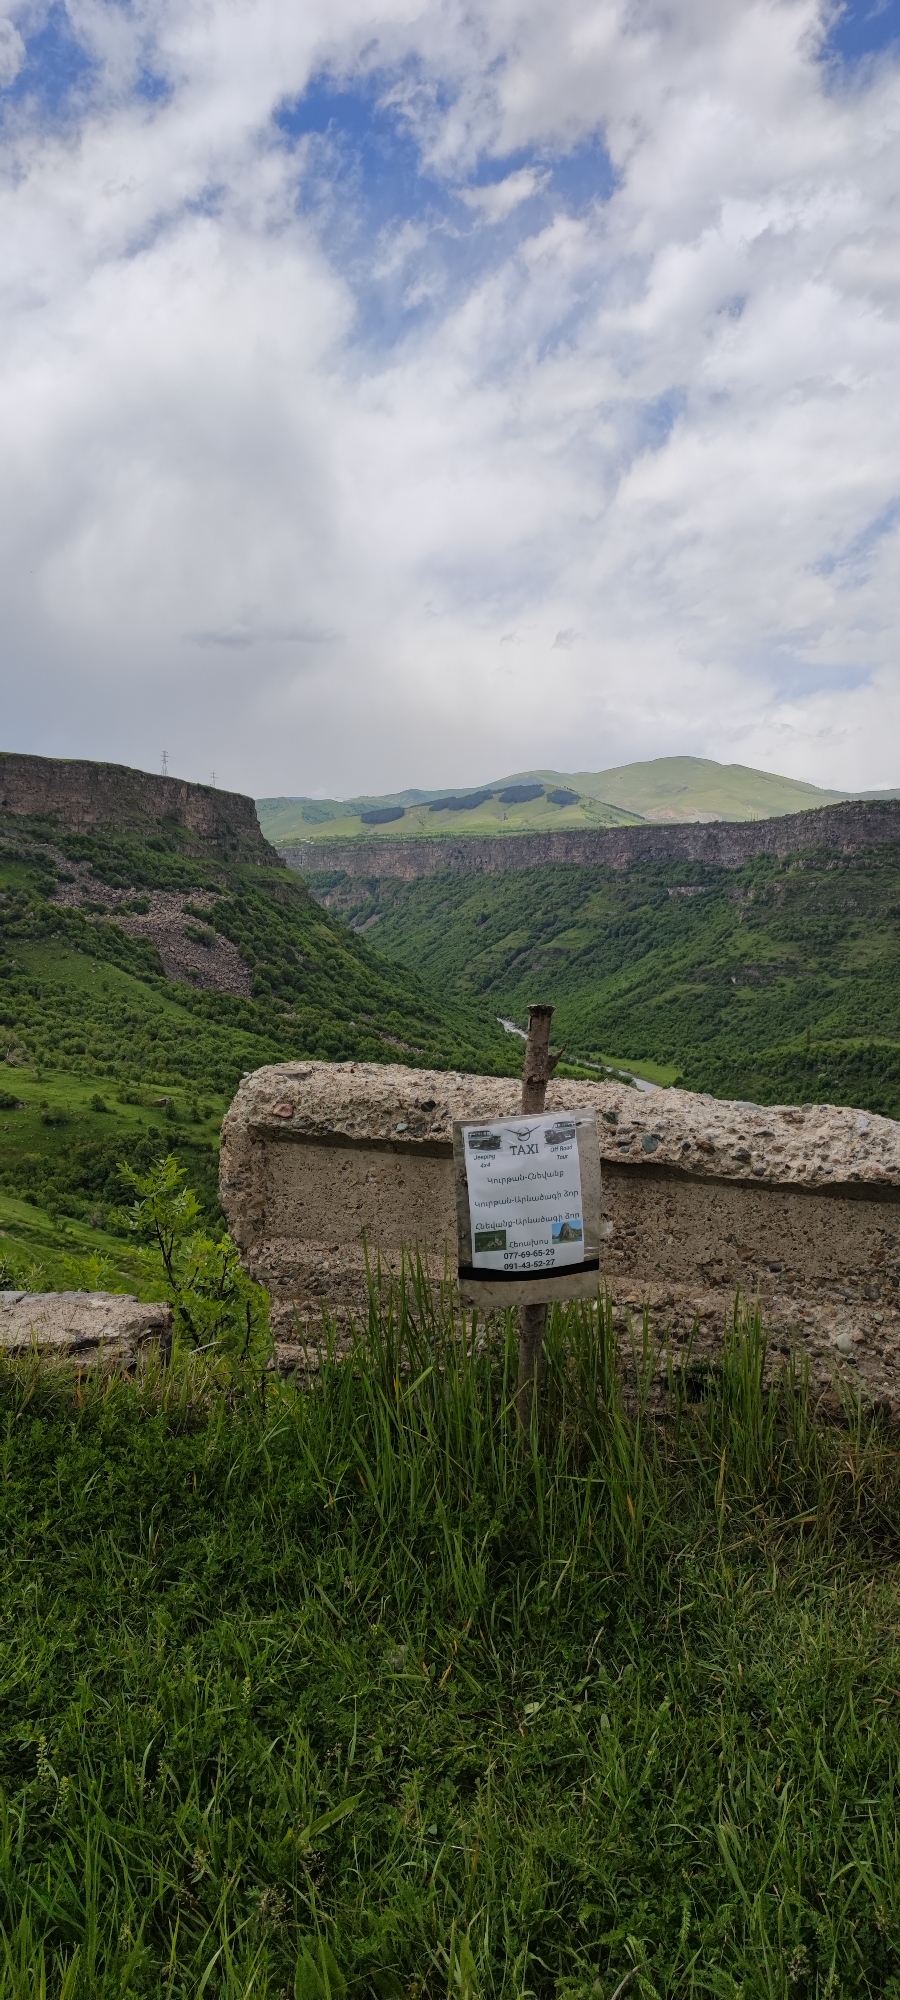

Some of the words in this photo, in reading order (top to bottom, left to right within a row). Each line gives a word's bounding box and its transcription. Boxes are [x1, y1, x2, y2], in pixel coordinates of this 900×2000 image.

[509, 1143, 540, 1156] TAXI
[487, 1170, 564, 1185] Կուրթան-Հնեվանք
[509, 1239, 549, 1249] Հեռախոս
[503, 1248, 555, 1260] 077-69-65-29
[503, 1259, 555, 1270] 091-43-52-27
